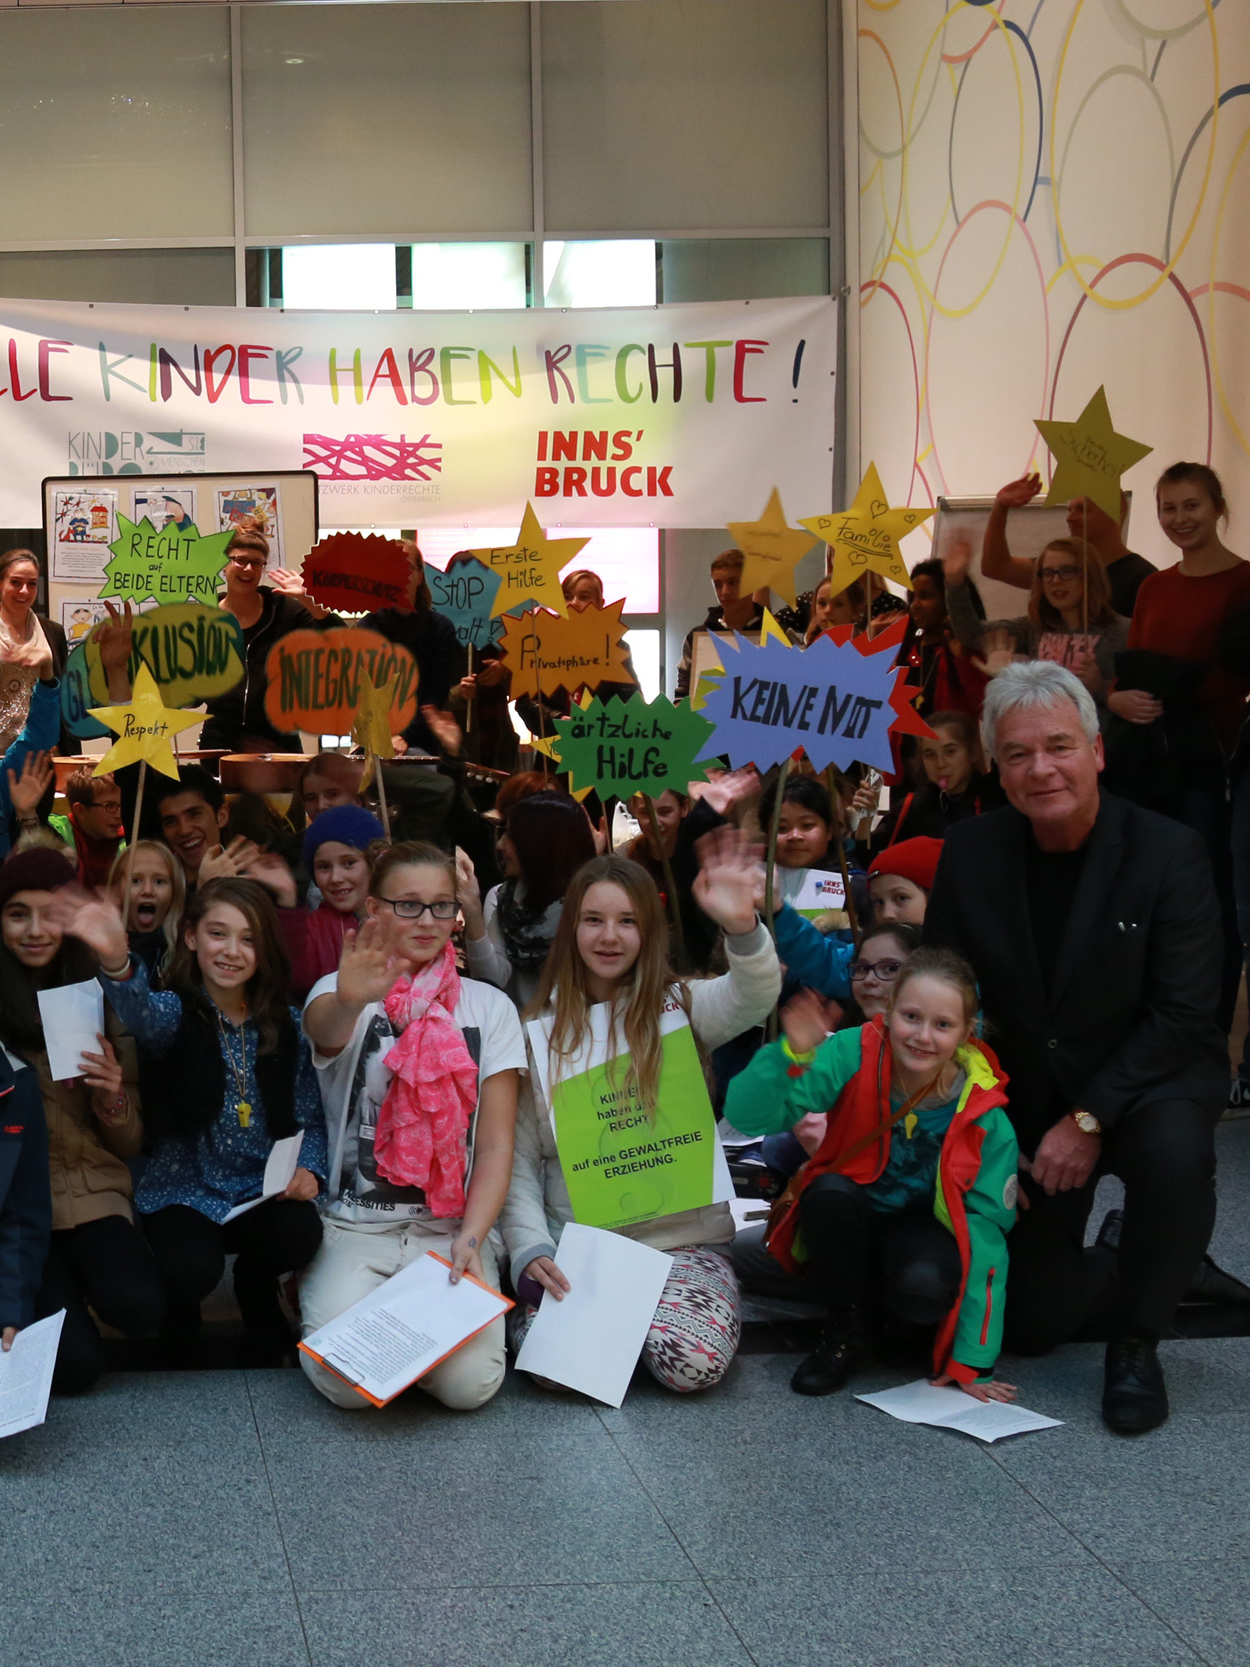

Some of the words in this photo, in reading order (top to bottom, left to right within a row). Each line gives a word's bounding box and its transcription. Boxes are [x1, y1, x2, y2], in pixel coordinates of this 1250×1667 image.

[99, 341, 304, 404] KINDER
[328, 343, 522, 406] HABEN
[544, 339, 770, 404] RECHTE
[68, 431, 145, 460] KINDER
[536, 429, 644, 462] INNS'
[363, 484, 441, 495] KINDERRECHTE
[534, 465, 675, 498] BRUCK
[130, 533, 196, 561] RECHT
[490, 546, 543, 565] Erste
[148, 562, 164, 573] auf
[507, 567, 546, 589] Hilfe
[113, 572, 153, 590] BEIDE
[159, 574, 217, 595] ELTERN
[730, 675, 819, 731] KEINE
[123, 713, 169, 741] Respekt
[609, 1114, 648, 1132] RECHT
[572, 1157, 591, 1173] auf
[592, 1152, 618, 1168] eine
[618, 1130, 703, 1161] GEWALTFREIE
[604, 1153, 678, 1179] ERZIEHUNG.
